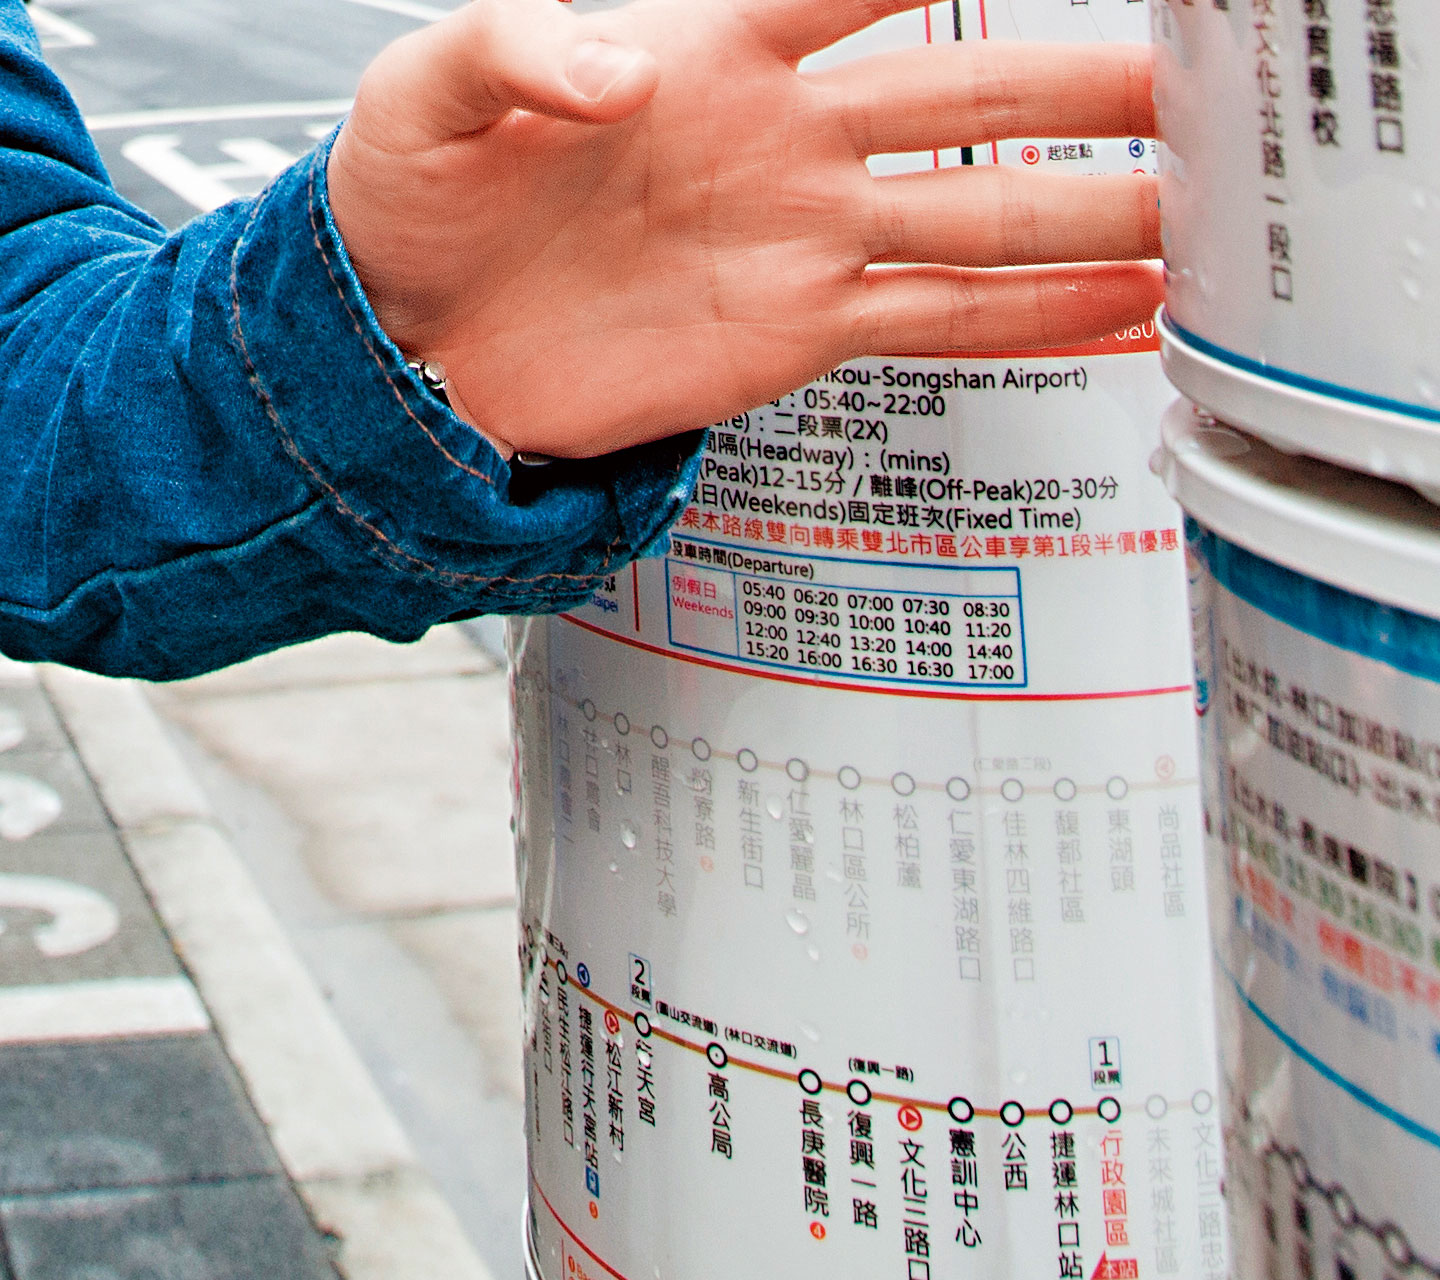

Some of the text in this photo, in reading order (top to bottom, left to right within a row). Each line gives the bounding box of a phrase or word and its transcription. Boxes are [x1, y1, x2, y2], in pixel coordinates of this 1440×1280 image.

[1047, 143, 1095, 162] 起迄點
[803, 387, 947, 417] 05:40~22:00
[869, 472, 1120, 506] 離峰(Off-Peak)20-30分
[1018, 506, 1082, 532] Time)
[671, 574, 718, 601] 例假日
[671, 594, 735, 621] Weekends
[742, 579, 1011, 618] 05:40 06:20 07:00 07:30 08:30
[743, 599, 1013, 639] 09:00 09:30 10:00 10:40 11:20
[744, 620, 1014, 660] 12:00 12:40 13:20 14:00 14:40
[745, 639, 1015, 681] 15:20 16:00 16:30 16:30 17:00
[736, 777, 765, 891] 新生街口
[786, 786, 818, 903] 仁愛麗晶
[838, 796, 872, 940] 林口區公所
[1054, 808, 1087, 925] 馥都社區
[1104, 808, 1136, 893] 東湖頭
[1156, 800, 1188, 919] 尚品社區
[946, 808, 982, 983] 仁愛東湖路口
[1001, 809, 1036, 983] 佳林四維路口
[633, 958, 646, 987] 2
[1097, 1040, 1113, 1068] 1
[706, 1071, 734, 1161] 高公局
[798, 1097, 831, 1218] 長庚醫院
[846, 1109, 880, 1232] 復興一路
[948, 1127, 984, 1250] 憲訓中心
[999, 1131, 1030, 1192] 公西
[1048, 1130, 1084, 1280] 捷運林口站
[1099, 1129, 1130, 1247] 行政園區
[1146, 1126, 1180, 1276] 未來城社區
